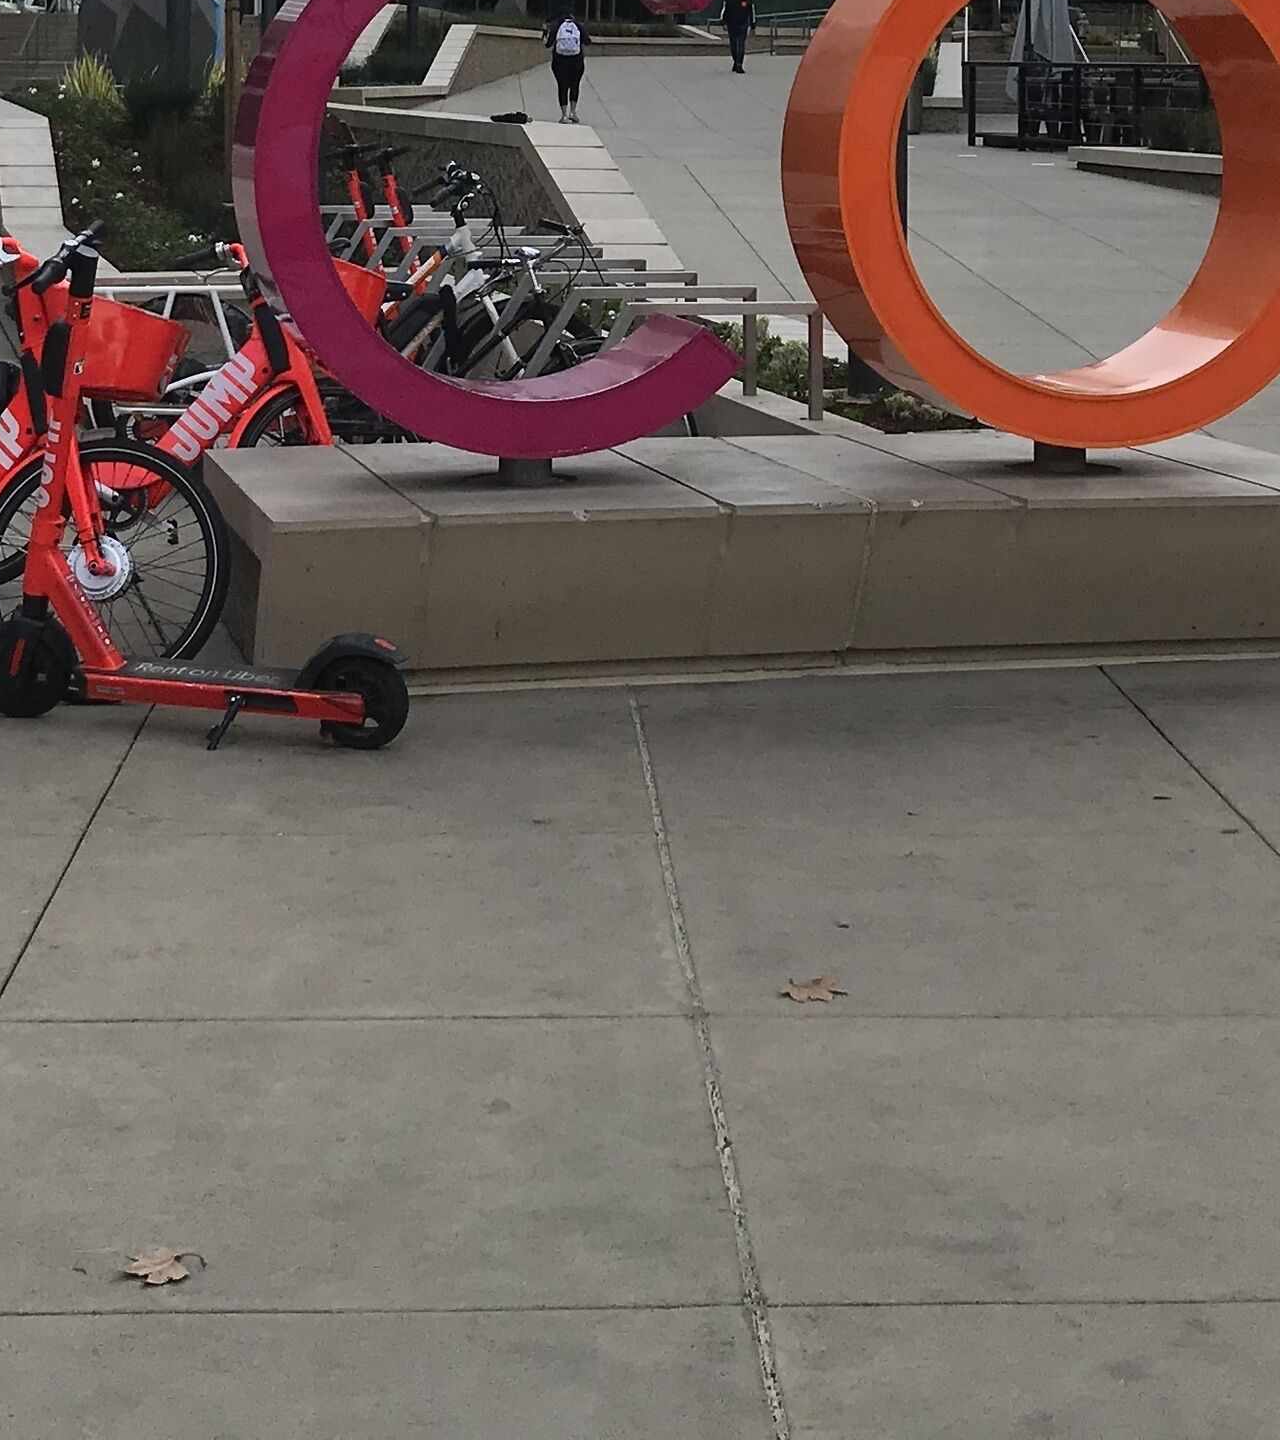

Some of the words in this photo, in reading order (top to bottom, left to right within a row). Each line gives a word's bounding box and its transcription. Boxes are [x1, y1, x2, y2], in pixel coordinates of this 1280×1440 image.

[171, 351, 258, 461] JUMP
[135, 662, 187, 676] Rent
[189, 667, 220, 678] on
[222, 669, 280, 684] Uber
